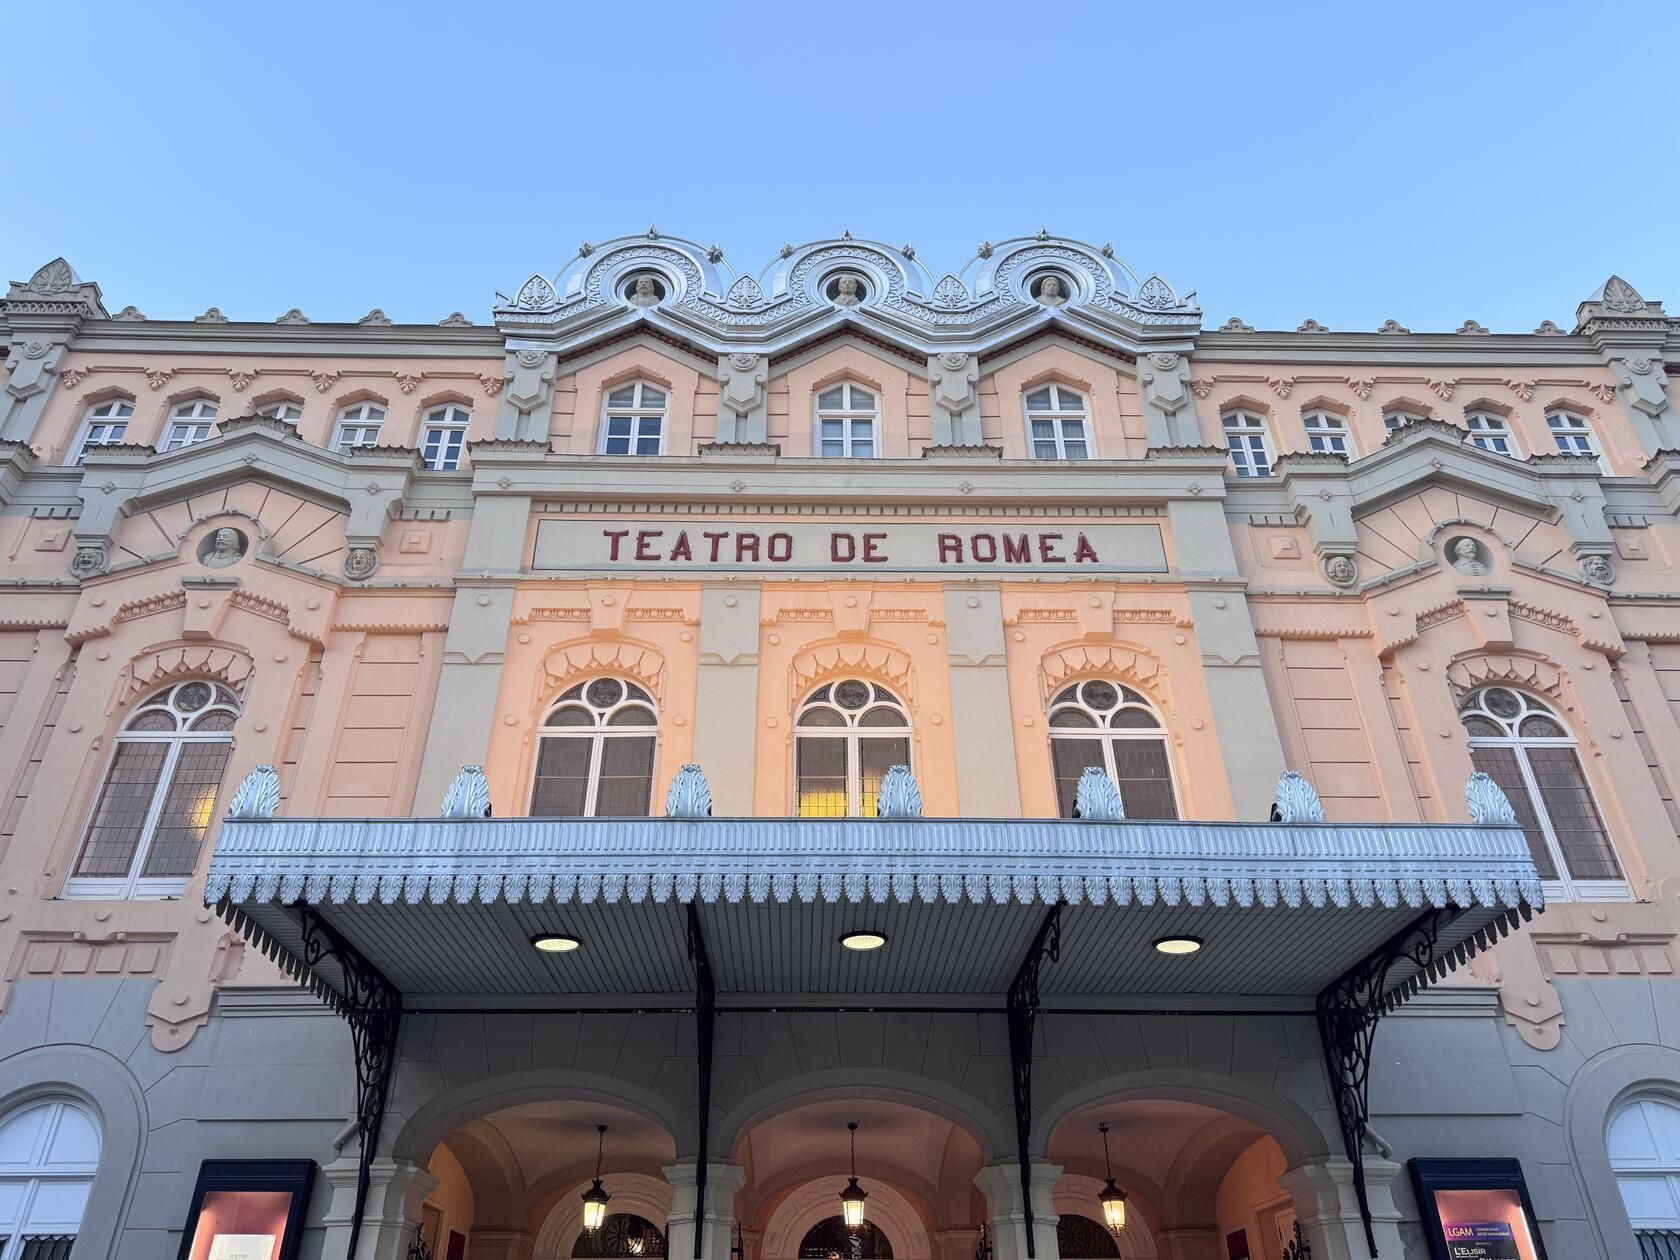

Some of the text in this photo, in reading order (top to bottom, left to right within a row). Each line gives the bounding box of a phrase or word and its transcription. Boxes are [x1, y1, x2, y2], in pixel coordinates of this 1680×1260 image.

[603, 529, 1099, 563] TEATRO DE ROMEA
[1447, 1227, 1474, 1236] LGAM
